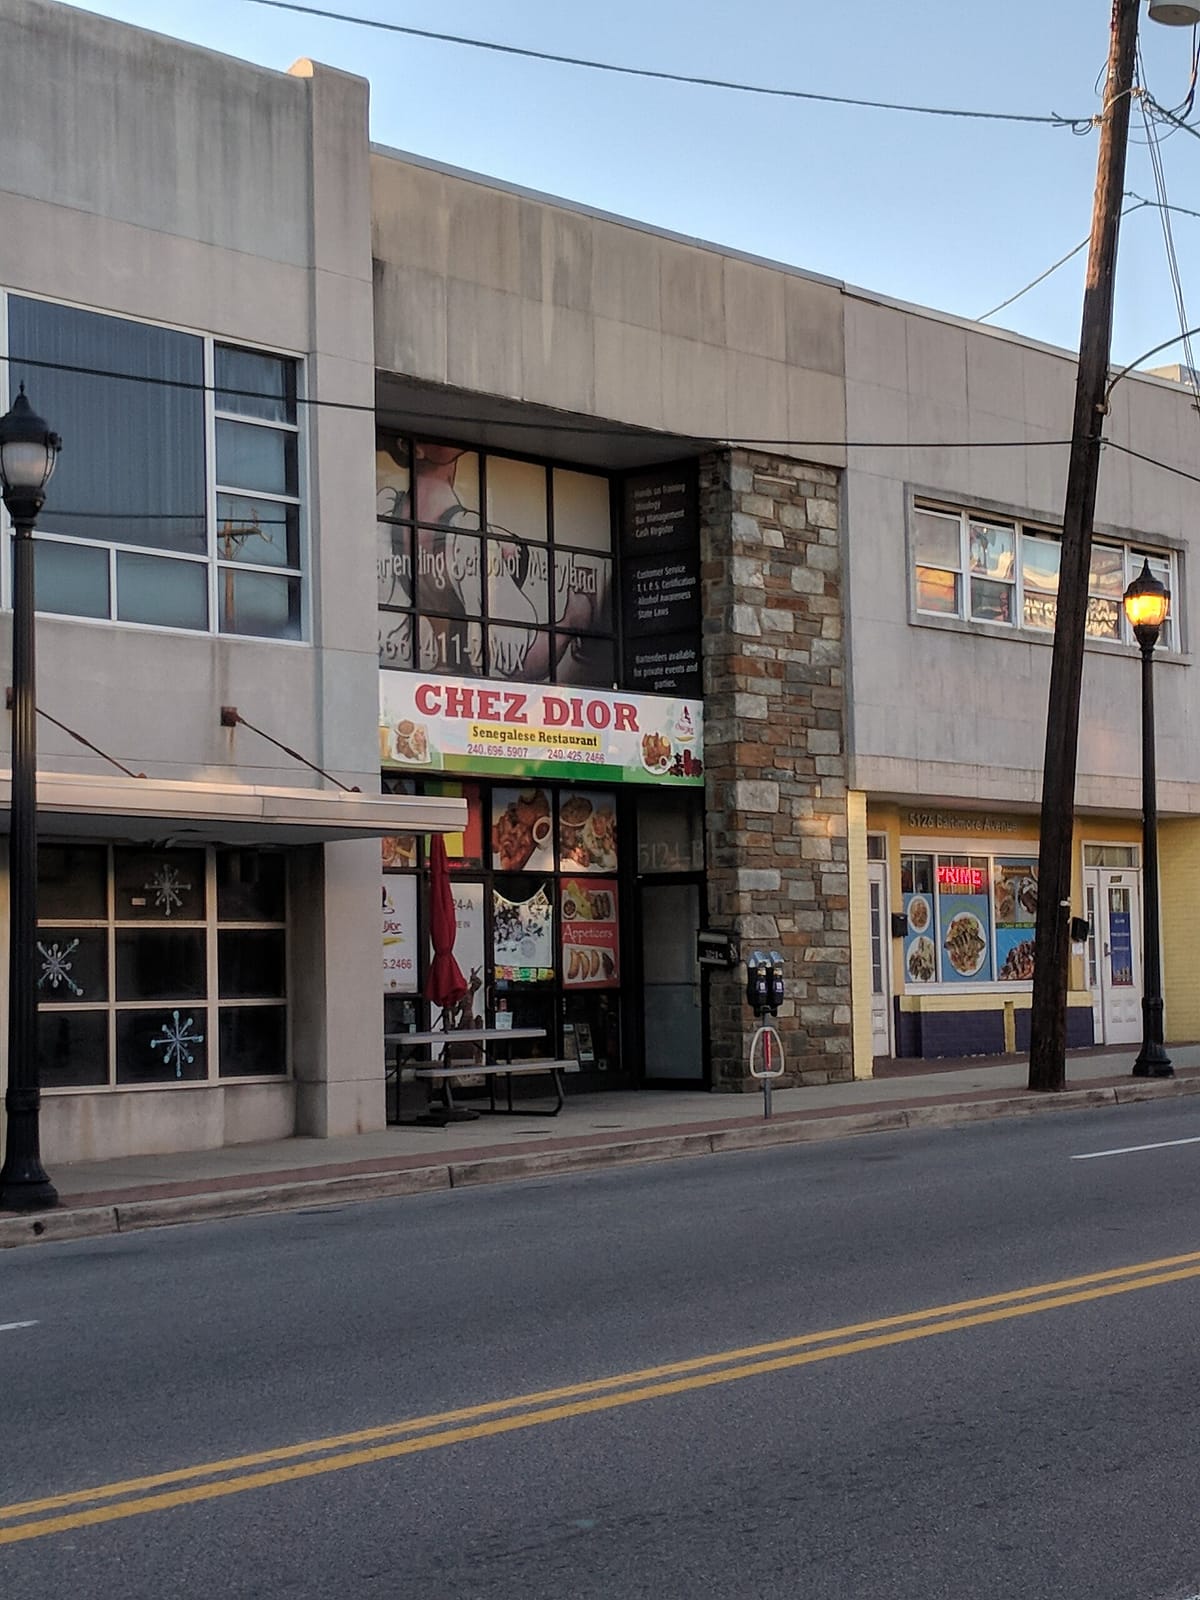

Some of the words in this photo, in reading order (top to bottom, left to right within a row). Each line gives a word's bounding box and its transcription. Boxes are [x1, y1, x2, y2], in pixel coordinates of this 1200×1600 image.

[507, 546, 521, 578] of
[637, 568, 664, 580] Customer
[664, 565, 686, 576] Service
[661, 577, 696, 590] Certification
[660, 591, 691, 602] Awareness
[638, 609, 653, 619] State
[653, 607, 669, 617] Laws
[668, 649, 696, 661] available
[643, 666, 664, 678] private
[664, 664, 685, 675] events
[685, 661, 698, 673] and
[414, 683, 528, 724] CHEZ
[542, 696, 640, 733] DIOR
[472, 725, 534, 743] Senegalese
[538, 731, 598, 748] Restaurant
[466, 743, 529, 759] 240.696.5907
[935, 814, 983, 831] Baltimore
[983, 817, 1018, 833] Avenue
[935, 867, 982, 885] PRIME
[562, 924, 614, 944] Appetizers
